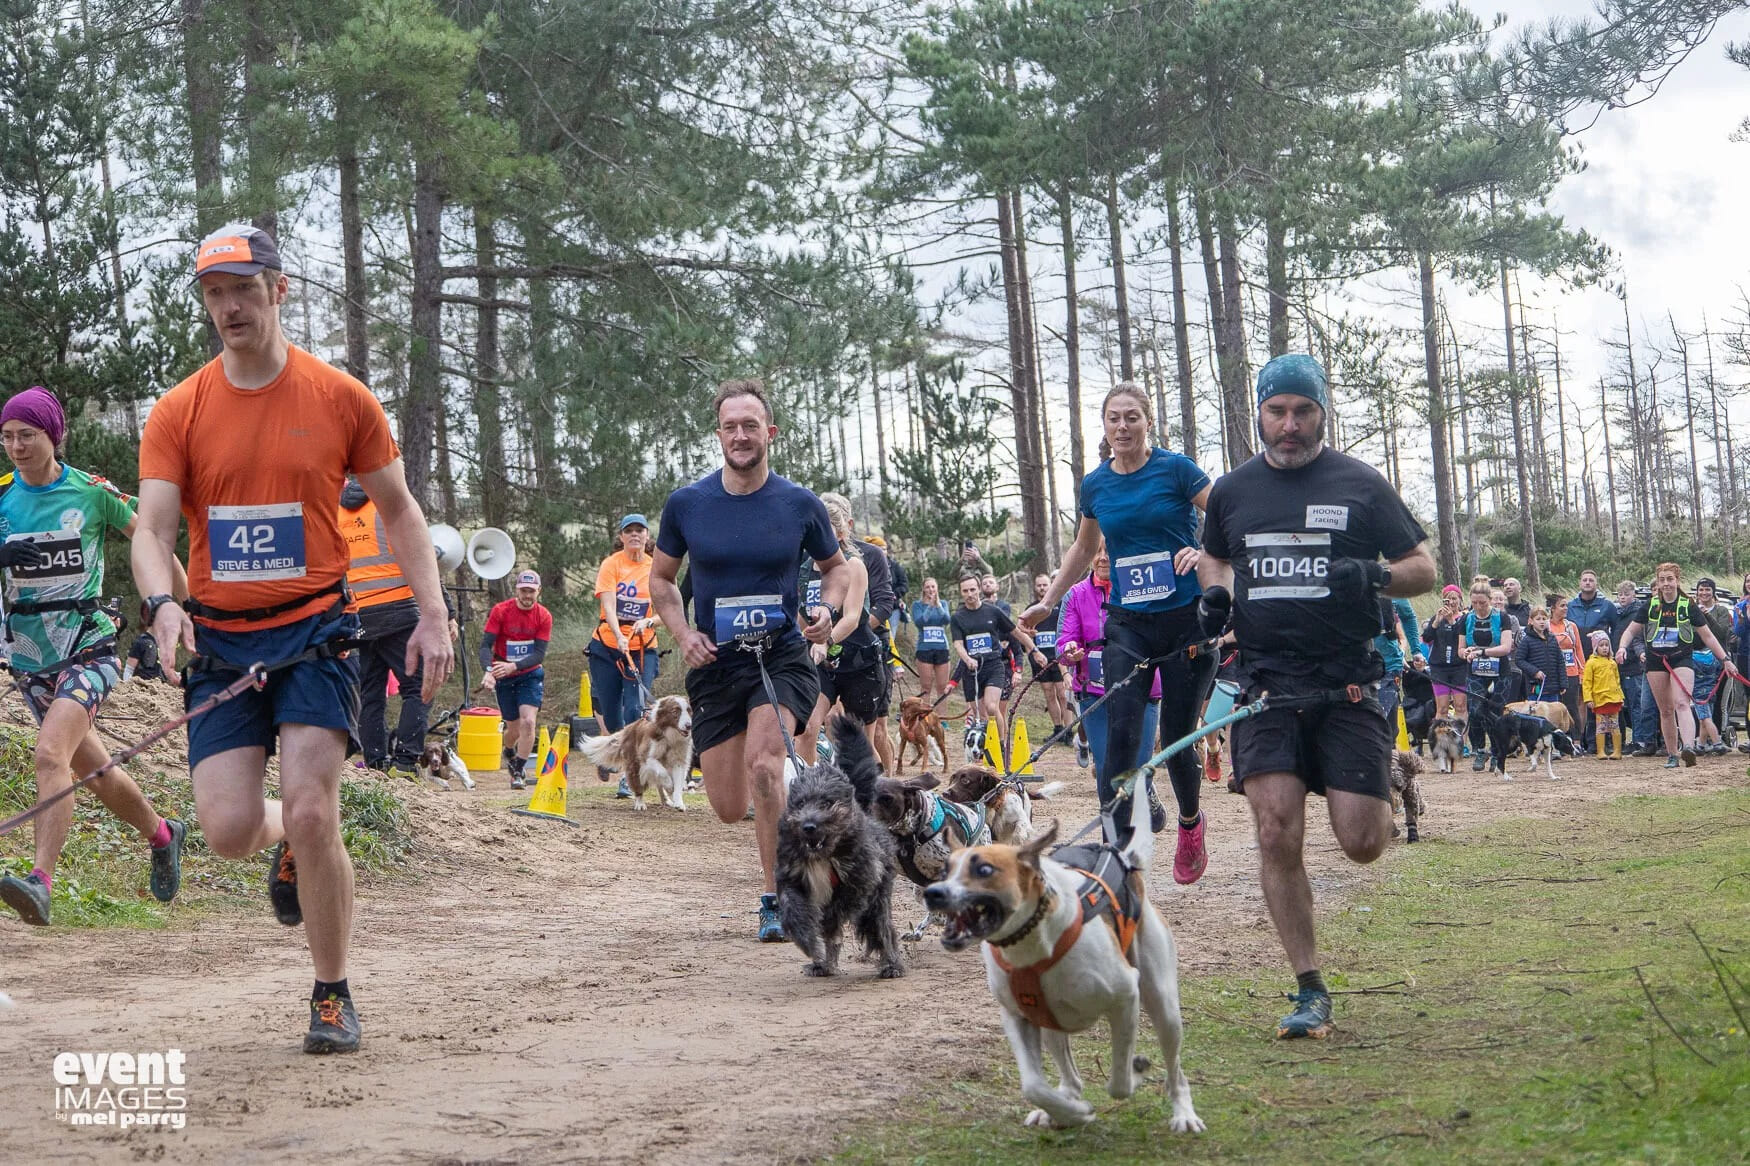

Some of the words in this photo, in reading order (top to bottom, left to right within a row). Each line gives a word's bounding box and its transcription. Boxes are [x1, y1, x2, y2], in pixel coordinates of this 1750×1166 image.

[1312, 508, 1343, 516] HOOND
[1314, 517, 1339, 525] racing
[228, 525, 276, 554] 42
[14, 548, 83, 572] 045
[217, 559, 250, 571] STEVE
[252, 559, 262, 570] &
[264, 556, 295, 569] MEDI
[1248, 556, 1330, 579] 10046
[1130, 565, 1155, 586] 31
[1125, 590, 1142, 598] JESS
[1147, 584, 1169, 594] GWEN
[623, 602, 641, 615] 22
[732, 608, 767, 630] 40
[972, 638, 986, 648] 24
